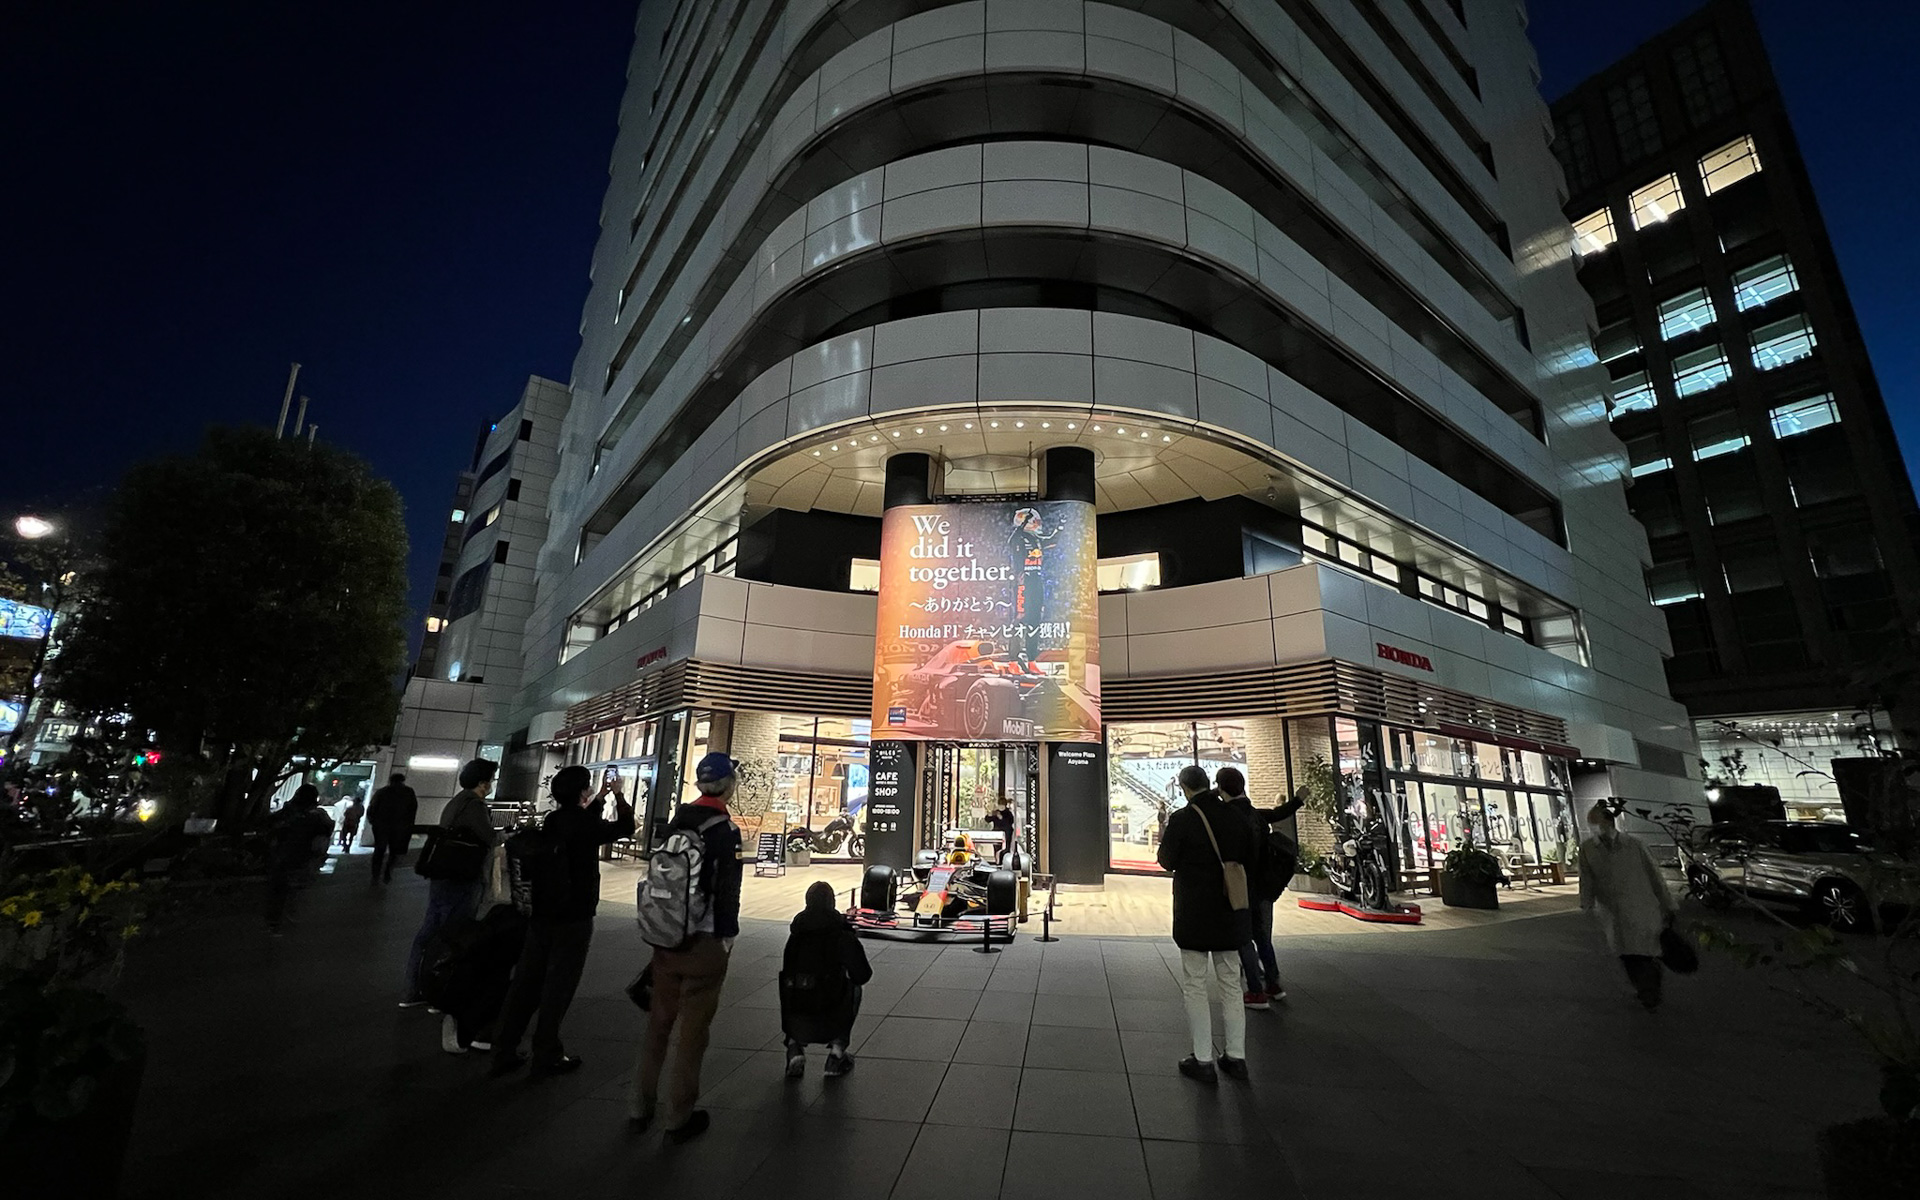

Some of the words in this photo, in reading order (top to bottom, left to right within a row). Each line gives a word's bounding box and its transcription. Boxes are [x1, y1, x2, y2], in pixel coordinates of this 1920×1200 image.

[911, 514, 951, 535] We
[910, 536, 949, 558] did
[956, 537, 974, 558] it
[909, 558, 1015, 590] together.
[899, 624, 941, 639] Honda
[1376, 642, 1434, 672] HONDA
[1003, 719, 1025, 736] Mobil
[875, 771, 899, 781] CAFE
[874, 787, 898, 796] SHOP
